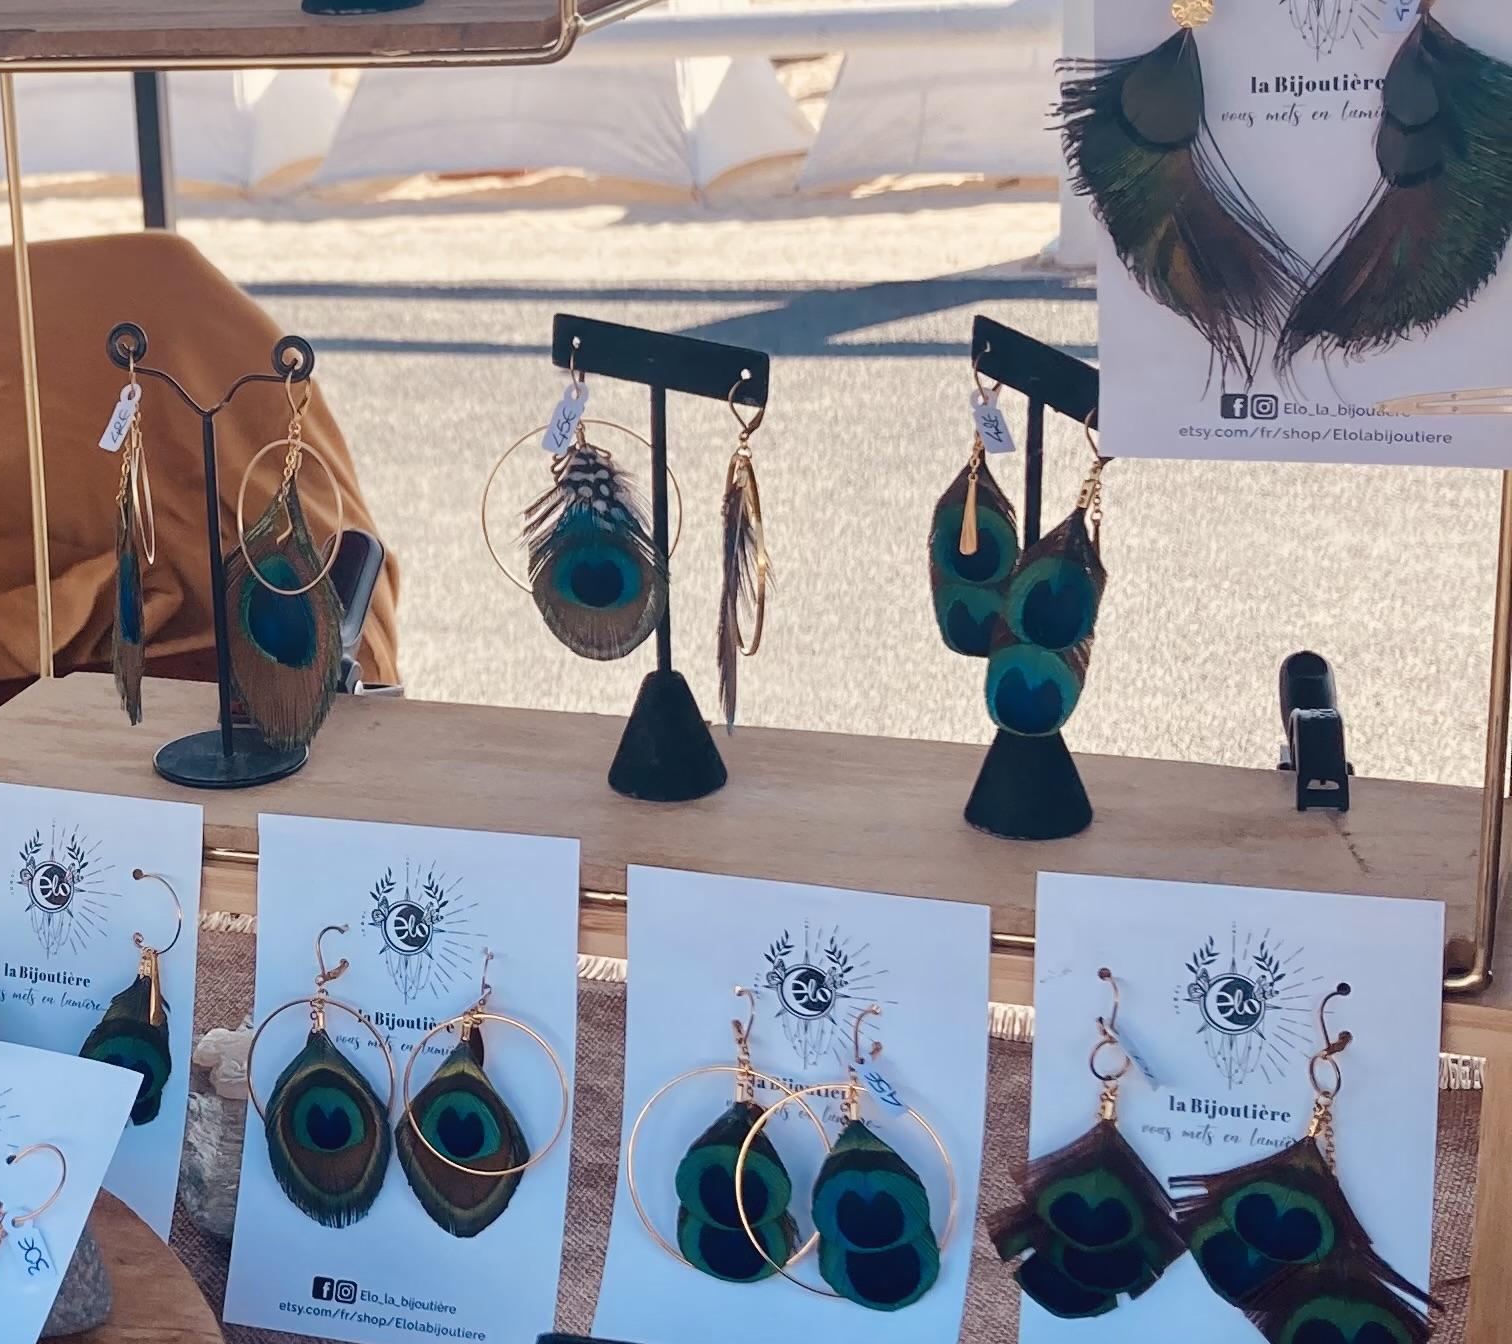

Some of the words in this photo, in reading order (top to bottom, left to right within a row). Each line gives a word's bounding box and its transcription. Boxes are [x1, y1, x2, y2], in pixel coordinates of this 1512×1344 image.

[1251, 76, 1270, 94] la
[1275, 73, 1385, 97] Bijoutière
[1284, 401, 1411, 418] Elo_la_bijou
[553, 407, 577, 447] 45€
[1178, 424, 1453, 446] etsy.com/fr/shop/Elolabijoutiere
[4, 962, 17, 977] la
[19, 965, 91, 987] Bijoutière
[374, 1011, 456, 1034] Bijoutièe
[863, 1071, 903, 1106] 45€
[1168, 1095, 1187, 1113] la
[1190, 1097, 1292, 1123] Bijoutière
[359, 1289, 458, 1315] Elo_la_bijoutière
[278, 1300, 487, 1342] etsy.com/fr/shop/Elolabijoutiere
